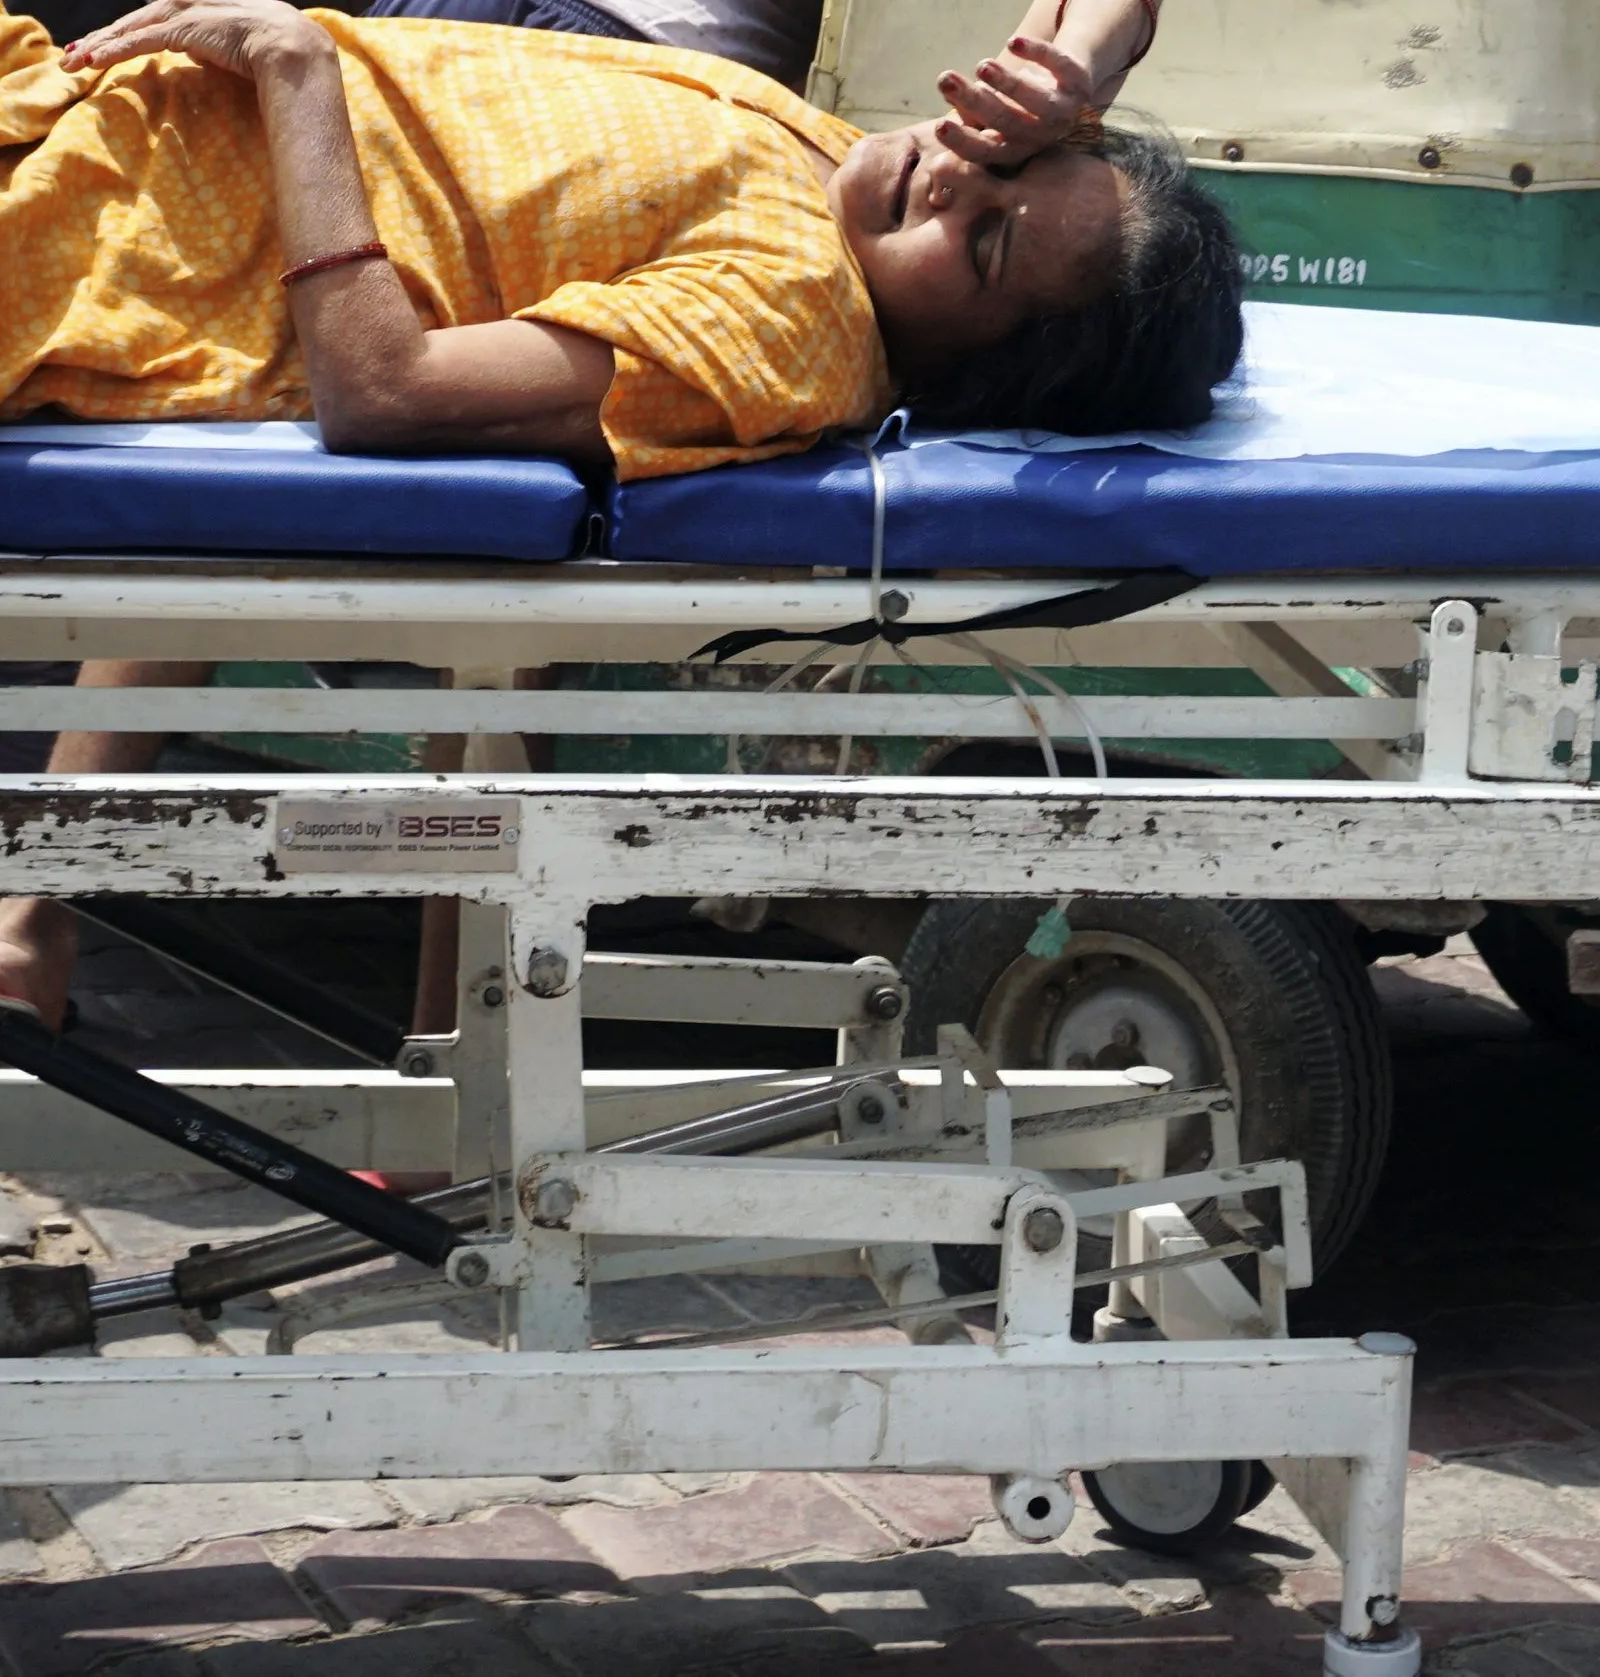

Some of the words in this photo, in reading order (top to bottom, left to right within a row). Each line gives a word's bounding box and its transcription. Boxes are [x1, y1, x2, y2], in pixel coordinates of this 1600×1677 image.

[295, 820, 361, 838] Supported
[366, 820, 383, 839] by
[398, 816, 501, 837] BSES
